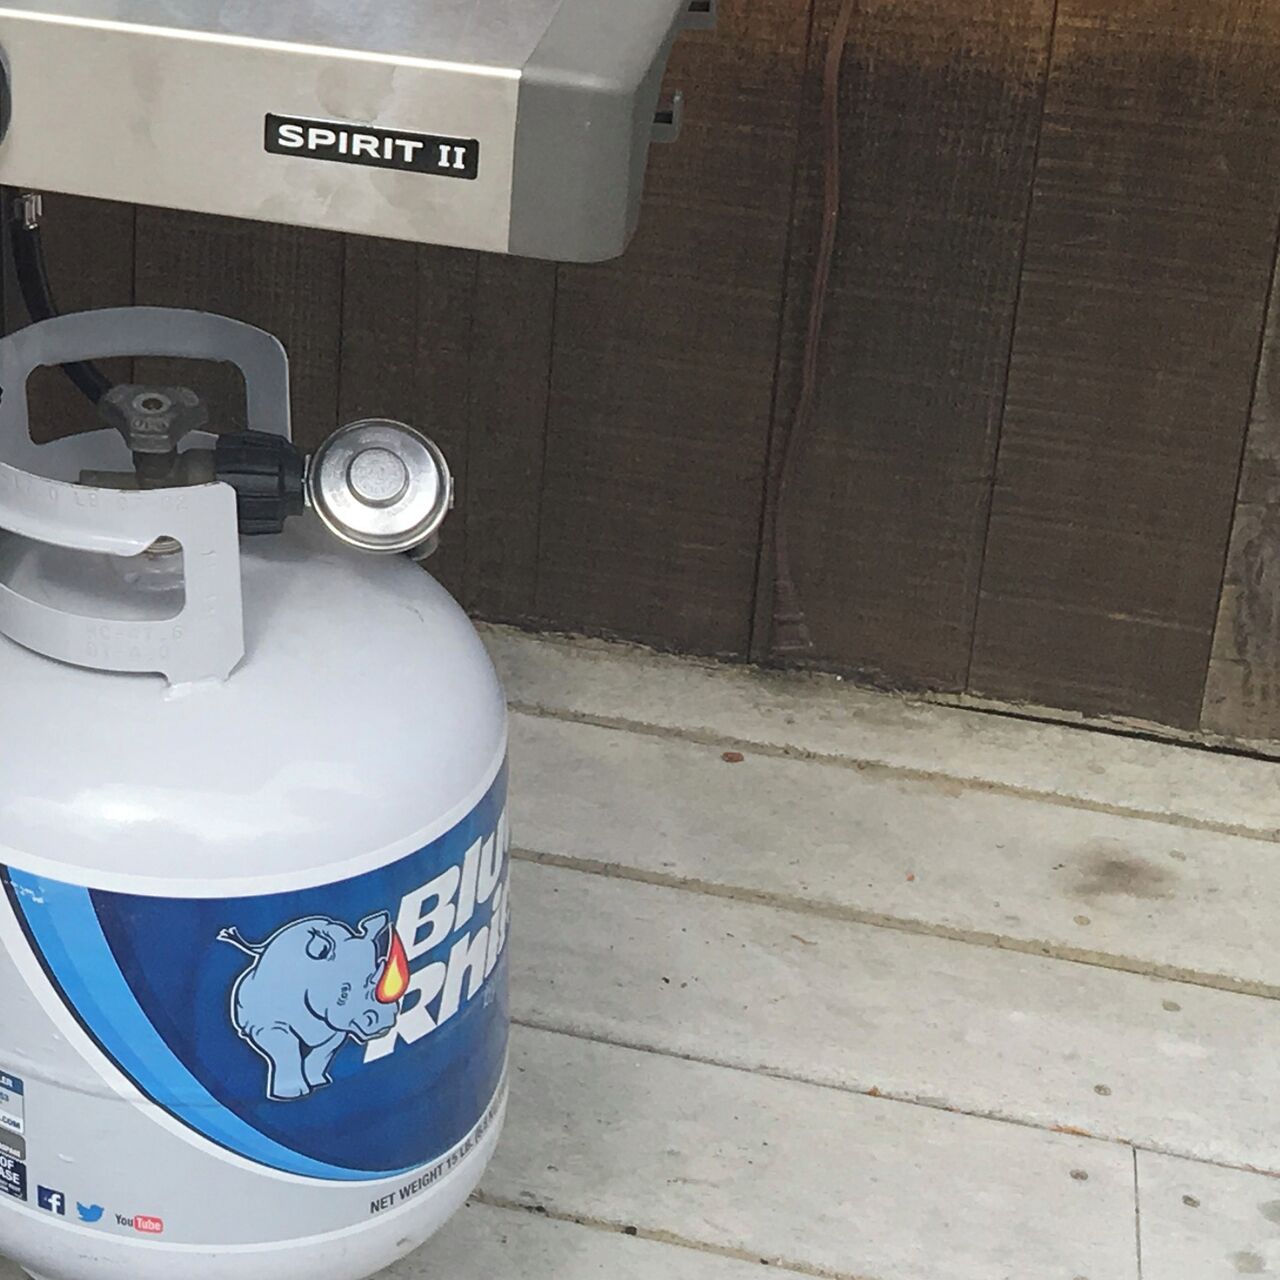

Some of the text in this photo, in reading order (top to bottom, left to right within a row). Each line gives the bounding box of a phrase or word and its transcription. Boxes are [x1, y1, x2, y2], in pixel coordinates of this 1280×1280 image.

[277, 123, 466, 170] SPIRIT II
[395, 807, 509, 959] Blu
[363, 880, 509, 1064] Rhi
[0, 1155, 15, 1170] OF
[369, 1192, 397, 1214] NET
[398, 1164, 445, 1201] WEIGHT
[445, 1153, 458, 1170] 15
[114, 1213, 163, 1232] YouTube
